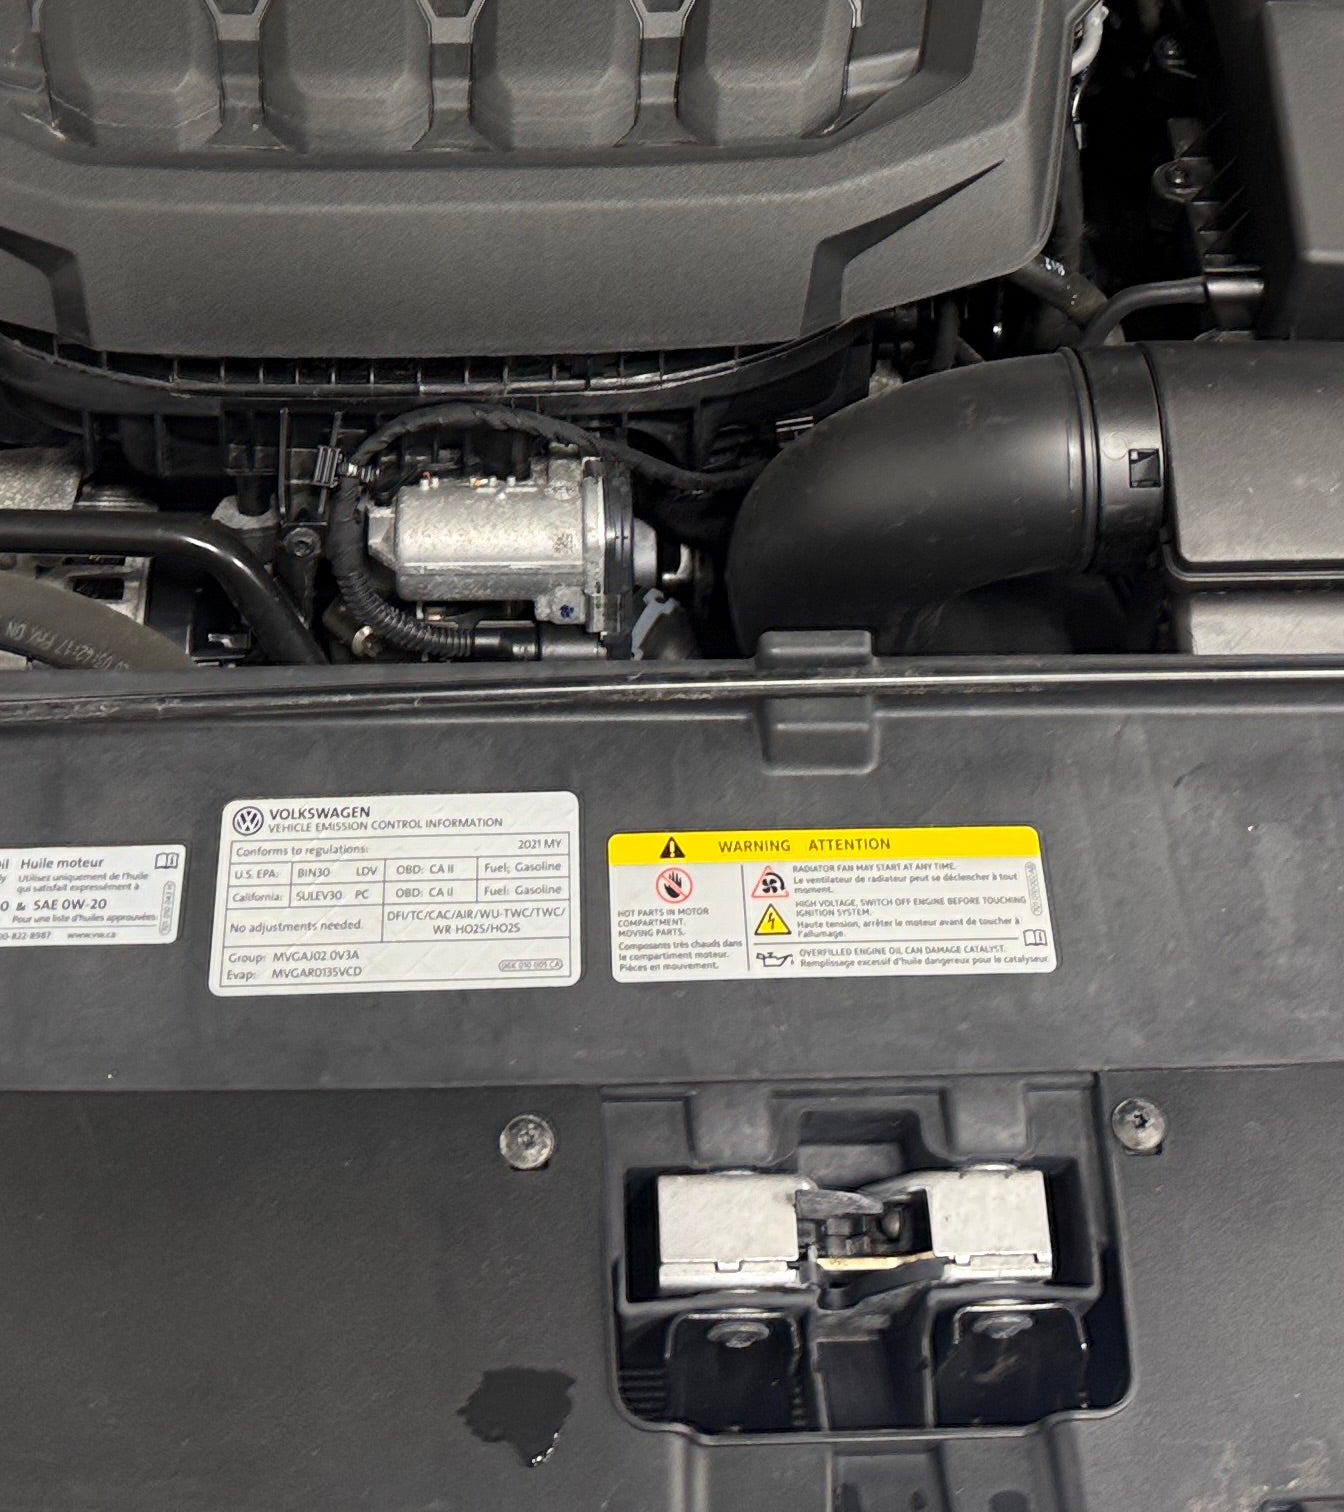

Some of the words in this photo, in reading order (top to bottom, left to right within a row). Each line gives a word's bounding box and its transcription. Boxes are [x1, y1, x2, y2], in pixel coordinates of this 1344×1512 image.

[269, 806, 371, 820] VOLKSWAGEN
[268, 822, 312, 833] VEHICLE
[316, 821, 368, 832] EMISSION
[371, 819, 422, 831] CONTROL
[425, 817, 503, 828] INFORMATION
[517, 839, 541, 850] 2021
[543, 839, 562, 849] MY
[718, 839, 791, 853] WARNING
[809, 837, 891, 852] ATTENTION
[236, 846, 288, 858] Conforms
[292, 846, 302, 856] to
[306, 844, 369, 858] regulations:
[20, 857, 54, 869] Huile
[56, 857, 104, 868] moteur
[484, 862, 511, 874] Fuel:
[514, 861, 562, 872] Gasoline
[792, 864, 836, 873] RADIATOR
[837, 864, 854, 872] FAN
[856, 864, 874, 872] MAY
[876, 863, 901, 871] START
[903, 863, 913, 871] AT
[915, 862, 933, 871] ANY
[257, 868, 279, 879] EPA:
[298, 867, 330, 878] BIN30
[356, 866, 377, 877] LDV
[396, 864, 423, 875] OBD:
[429, 864, 445, 874] CA
[794, 876, 804, 884] Le
[806, 875, 853, 884] ventilateur
[855, 875, 865, 883] de
[868, 874, 906, 883] radiateur
[909, 874, 929, 883] peut
[932, 874, 941, 882] se
[943, 872, 990, 881] déclencher
[999, 872, 1018, 881] tout
[296, 890, 343, 902] SULEV30
[355, 889, 369, 900] PC
[395, 887, 423, 898] OBD:
[428, 887, 444, 898] CA
[484, 885, 510, 896] Fuel:
[514, 884, 562, 895] Gasoline
[232, 891, 283, 902] California:
[795, 899, 816, 908] HIGH
[818, 899, 858, 908] VOLTAGE,
[860, 898, 893, 907] SWITCH
[894, 897, 911, 906] OFF
[913, 897, 945, 905] ENGINE
[947, 896, 980, 905] BEFORE
[982, 896, 1027, 905] TOUCHING
[16, 902, 26, 911] &
[33, 899, 58, 911] SAE
[61, 898, 108, 910] 0W-20
[617, 909, 635, 918] HOT
[637, 908, 664, 917] PARTS
[666, 908, 676, 916] IN
[677, 907, 709, 916] MOTOR
[796, 909, 835, 917] IGNITION
[229, 923, 246, 933] No
[248, 921, 317, 935] adjustments
[797, 920, 823, 929] Haute
[863, 919, 893, 928] arrêter
[895, 918, 903, 927] le
[905, 918, 937, 927] moteur
[939, 918, 964, 926] avant
[966, 917, 976, 925] de
[978, 916, 1012, 925] toucher
[618, 928, 654, 938] MOVING
[619, 941, 671, 951] Composants
[673, 940, 689, 948] très
[691, 939, 721, 948] chauds
[722, 939, 743, 947] dans
[799, 948, 852, 957] OVERFILLED
[854, 947, 886, 956] ENGINE
[888, 946, 903, 955] OIL
[905, 946, 923, 955] CAN
[925, 945, 961, 954] DAMAGE
[228, 952, 265, 965] Group:
[619, 953, 628, 961] le
[629, 951, 692, 962] compartiment
[800, 958, 855, 968] Remplissage
[857, 957, 891, 966] excessif
[924, 957, 970, 966] dangereux
[972, 956, 992, 965] pour
[994, 955, 1002, 963] le
[226, 969, 255, 982] Evap:
